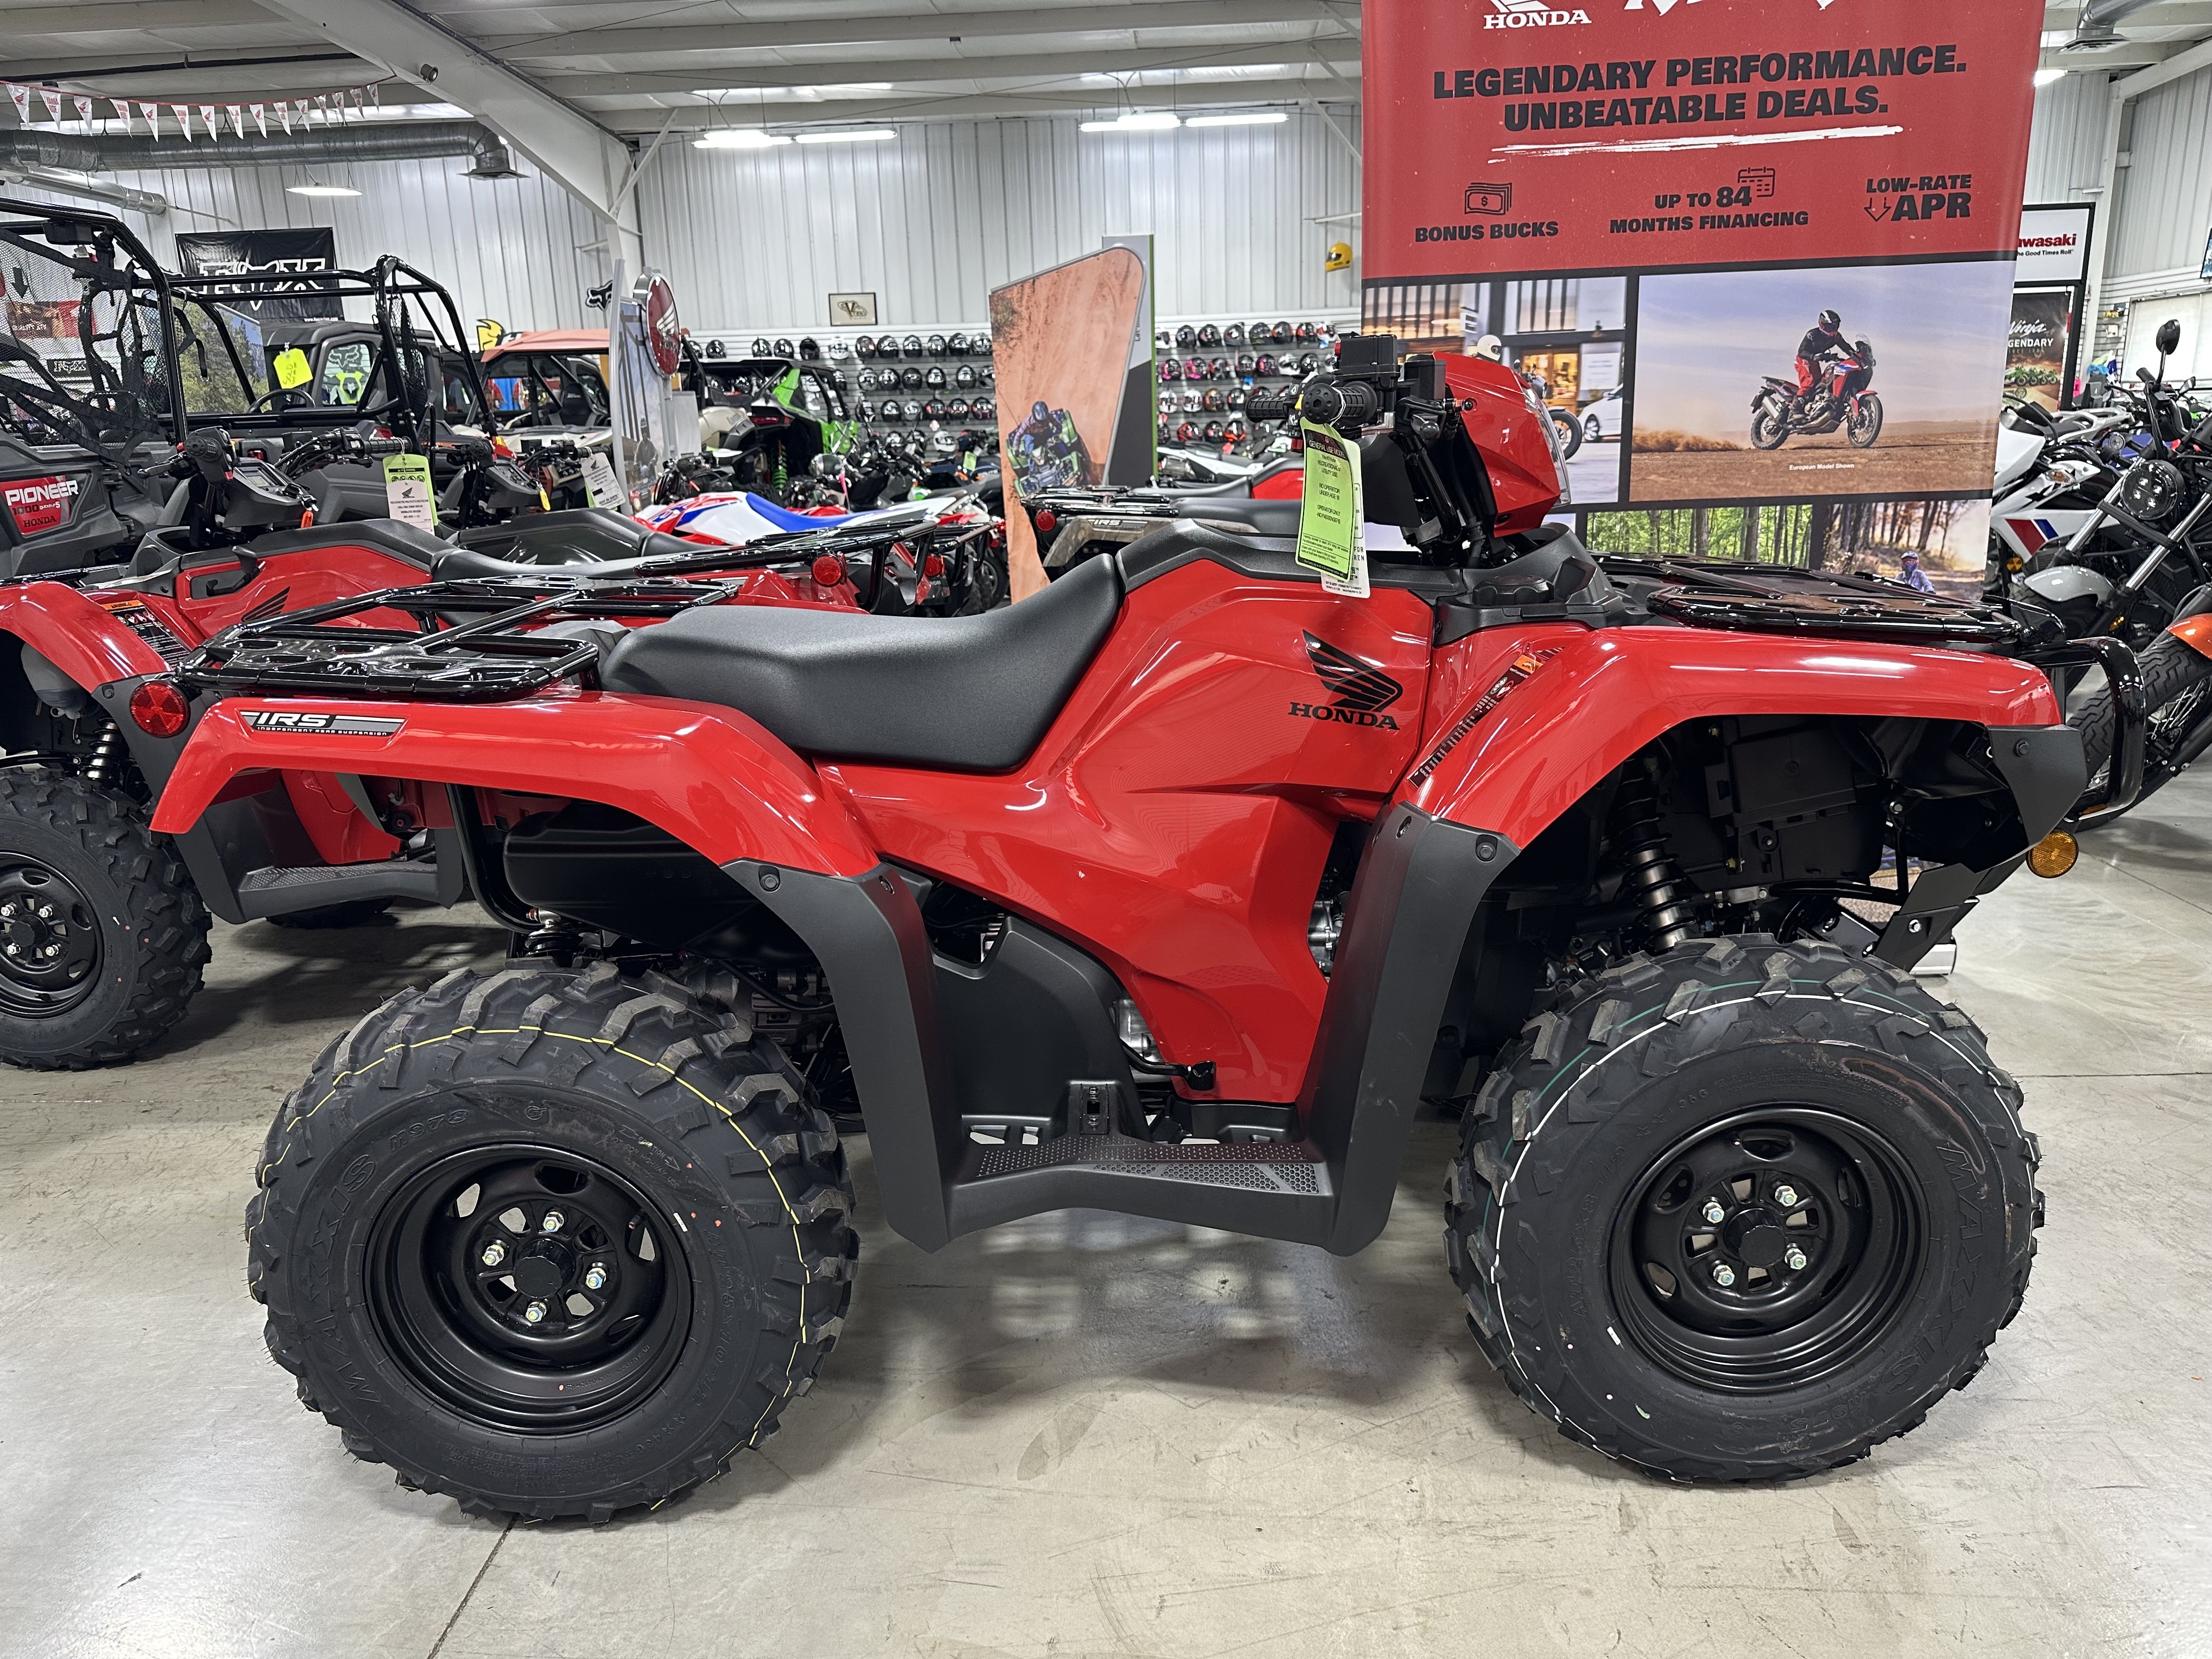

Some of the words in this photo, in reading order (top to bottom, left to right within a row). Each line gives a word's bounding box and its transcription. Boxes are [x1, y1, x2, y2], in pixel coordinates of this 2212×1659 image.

[1483, 9, 1592, 30] HONDA
[1433, 60, 1656, 99] LEGENDARY
[1666, 44, 1967, 87] PERFORMANCE.
[1504, 92, 1746, 132] UNBEATABLE
[1757, 85, 1888, 120] DEALS.
[1866, 174, 1972, 194] LOW-RATE
[1654, 194, 1680, 210] UP
[1687, 192, 1711, 208] TO
[1716, 186, 1752, 208] 84
[1891, 193, 1971, 222] APR
[1415, 224, 1485, 242] BONUS
[1489, 221, 1559, 240] BUCKS
[1610, 216, 1694, 234] MONTHS
[1699, 211, 1809, 230] FINANCING
[2018, 233, 2077, 248] wasaki
[2008, 338, 2053, 348] GENDARY
[5, 479, 79, 506] PIONEER
[12, 504, 40, 515] 1000
[23, 516, 57, 528] HONDA
[257, 713, 330, 726] IRS
[1288, 702, 1400, 730] HONDA
